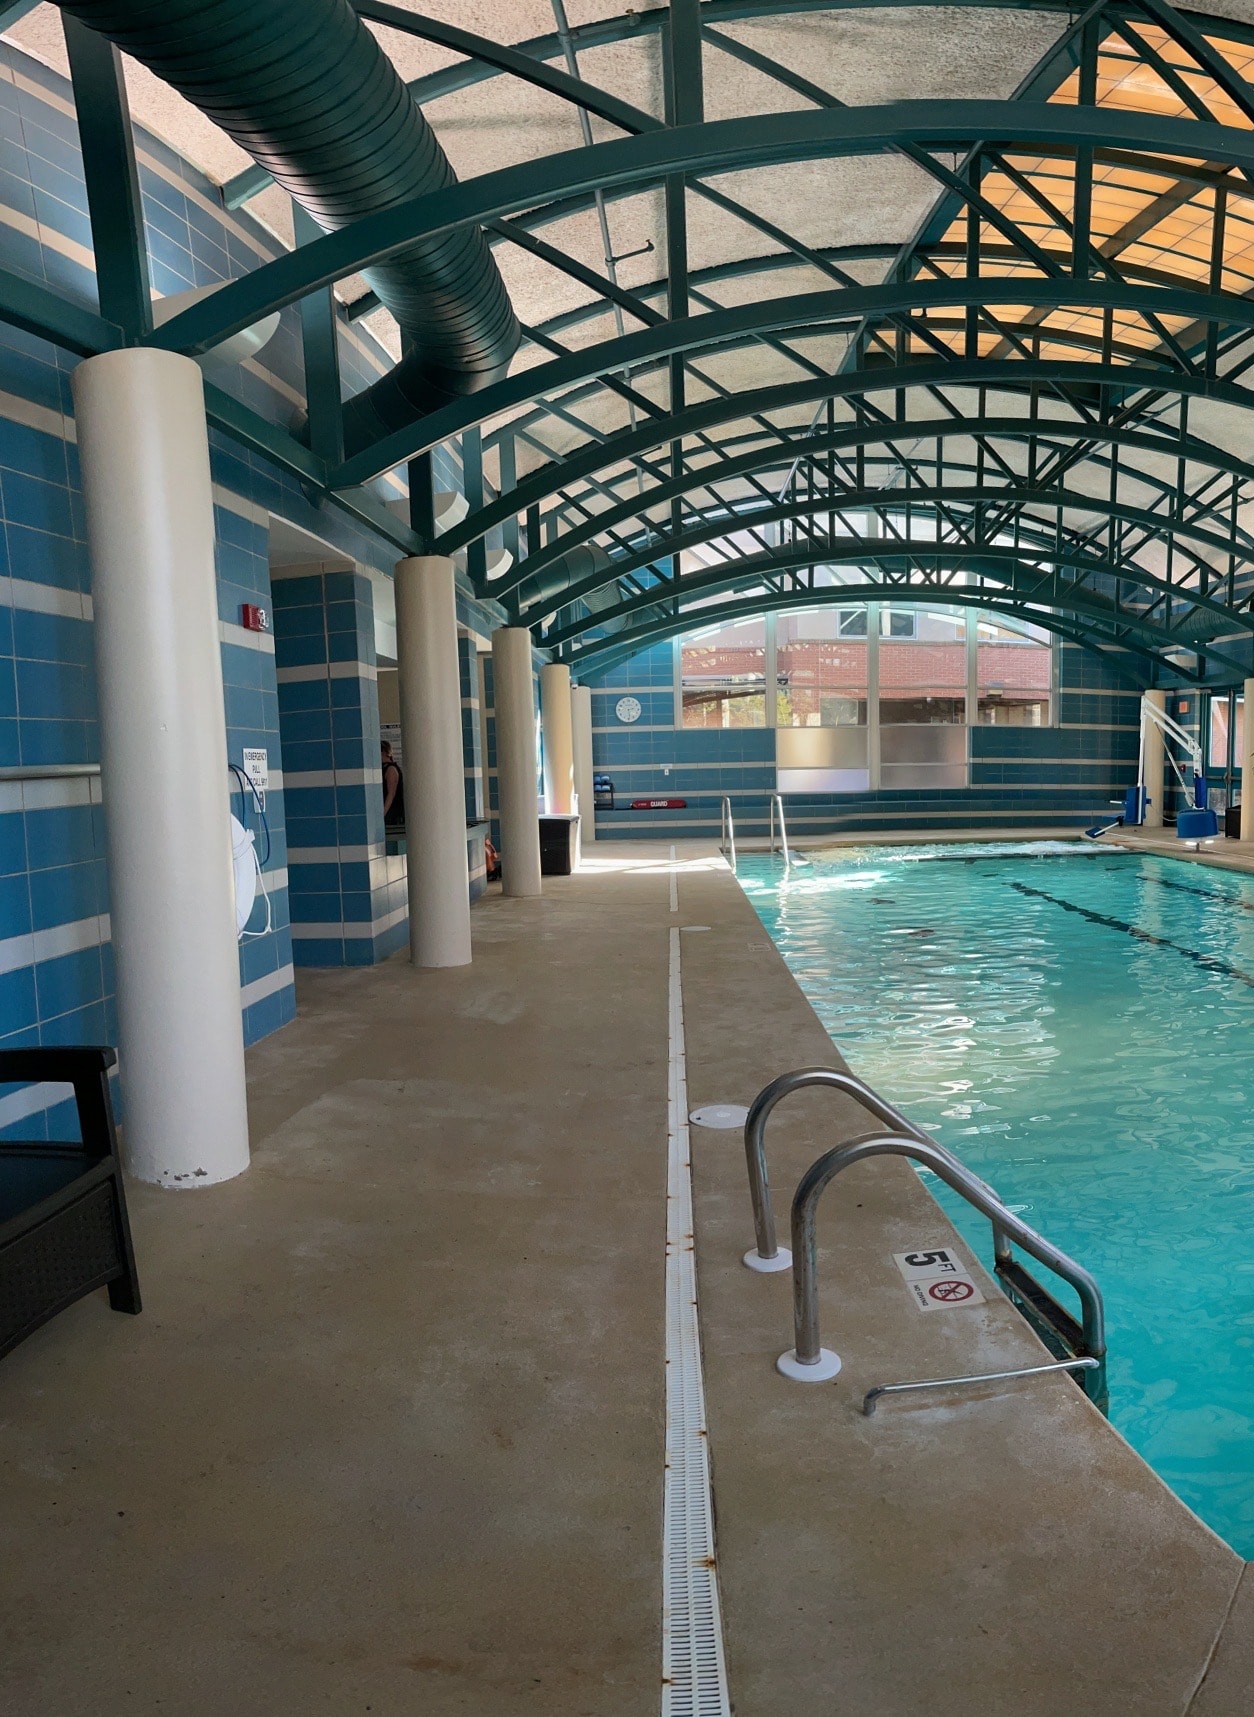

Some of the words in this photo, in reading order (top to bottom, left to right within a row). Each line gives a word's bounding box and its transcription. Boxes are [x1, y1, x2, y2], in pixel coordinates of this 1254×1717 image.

[248, 752, 267, 761] EMERGENCY
[905, 1250, 950, 1267] 5
[938, 1262, 956, 1273] FT
[914, 1284, 921, 1292] NO
[917, 1291, 929, 1306] DIVING
